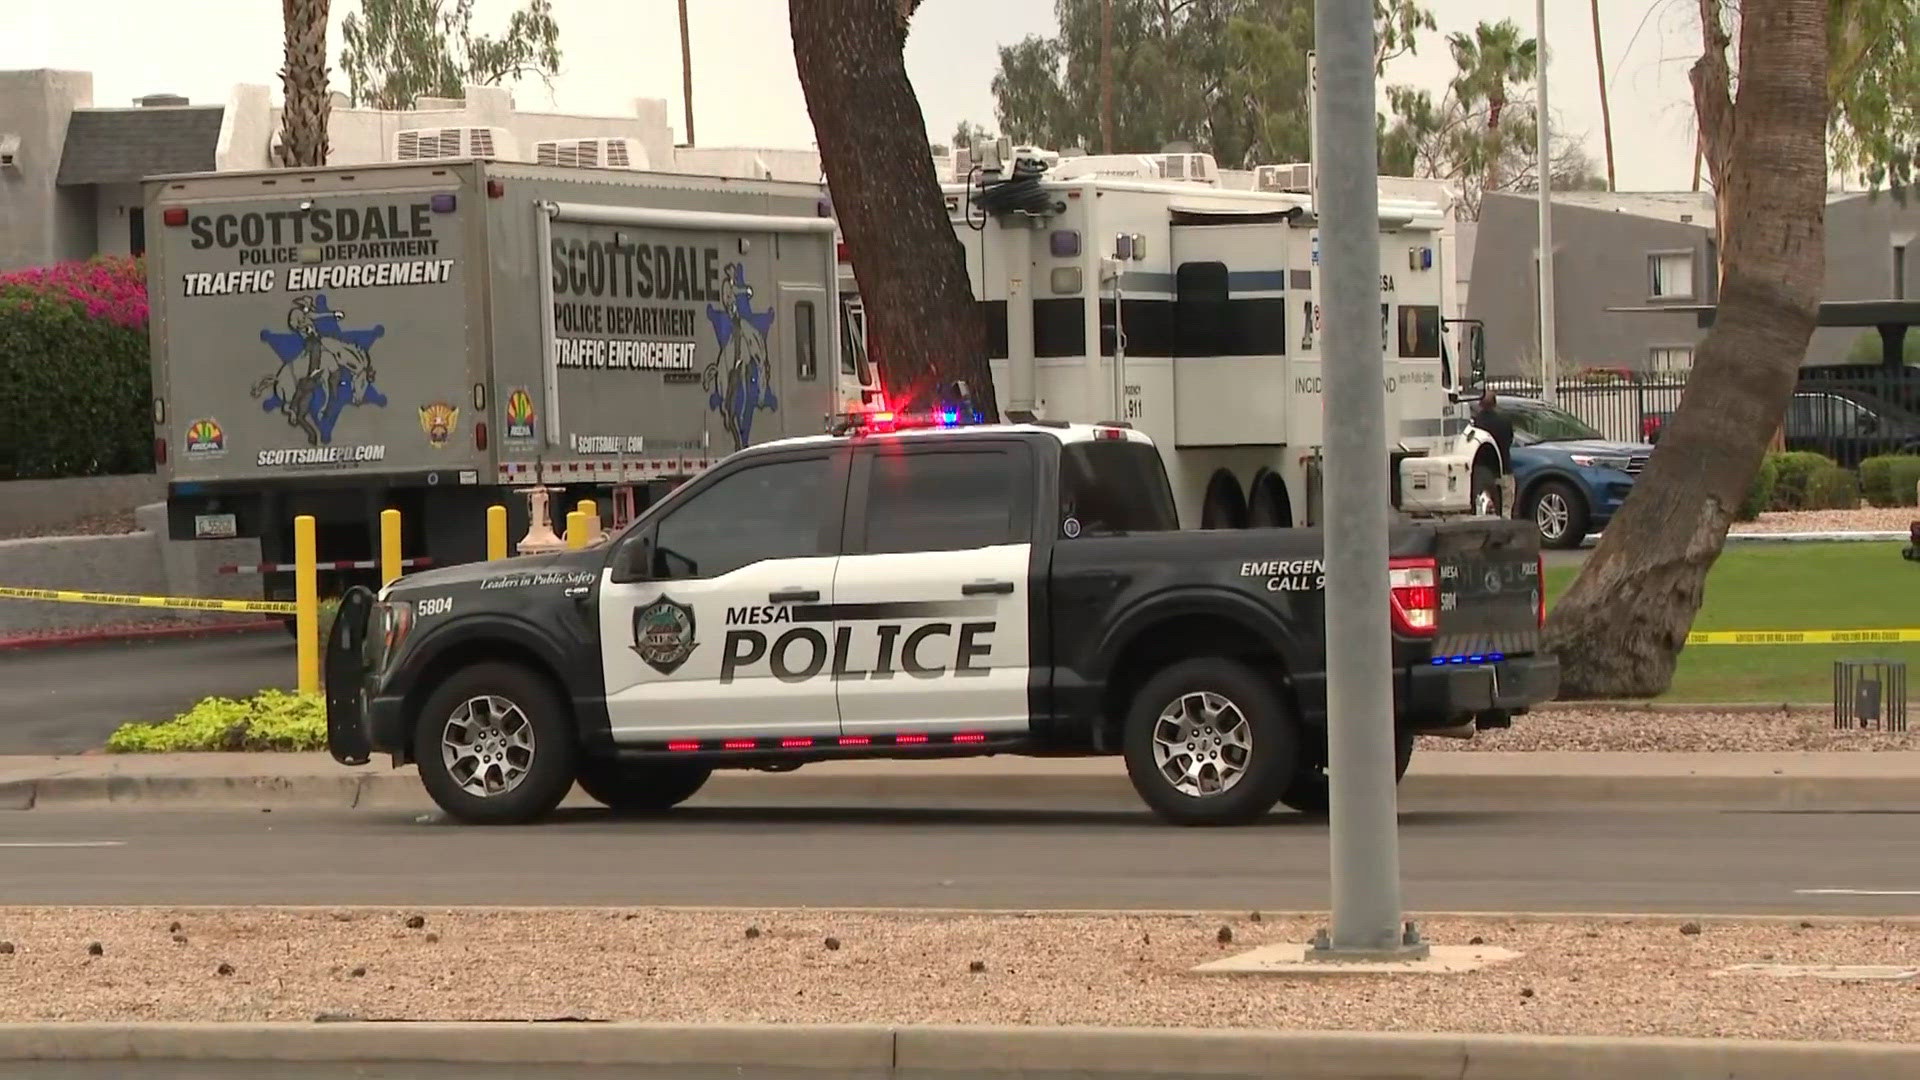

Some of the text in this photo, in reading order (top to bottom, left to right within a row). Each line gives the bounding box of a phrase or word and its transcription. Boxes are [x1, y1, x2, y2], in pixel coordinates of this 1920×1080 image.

[191, 204, 432, 249] SCOTTSDALE
[239, 240, 439, 265] POLICE DEPARTMENT
[184, 260, 454, 296] TRAFFIC ENFORCEMENT
[551, 237, 720, 301] SCOTTSDALE
[1380, 274, 1395, 292] SA
[554, 303, 696, 336] POLICE DEPARTMENT
[555, 338, 696, 371] TRAFFIC ENFORCEMENT
[1295, 378, 1322, 393] INCID
[1128, 400, 1142, 418] 911
[257, 445, 385, 466] SCOTTSDALEPD.COM
[1240, 559, 1326, 577] EMERGEN
[1440, 565, 1459, 579] MESA
[480, 571, 596, 590] Leaders in Public Safety
[1266, 576, 1310, 591] CALL
[418, 597, 453, 617] 5804
[725, 605, 790, 625] MESA
[719, 622, 997, 684] POLICE
